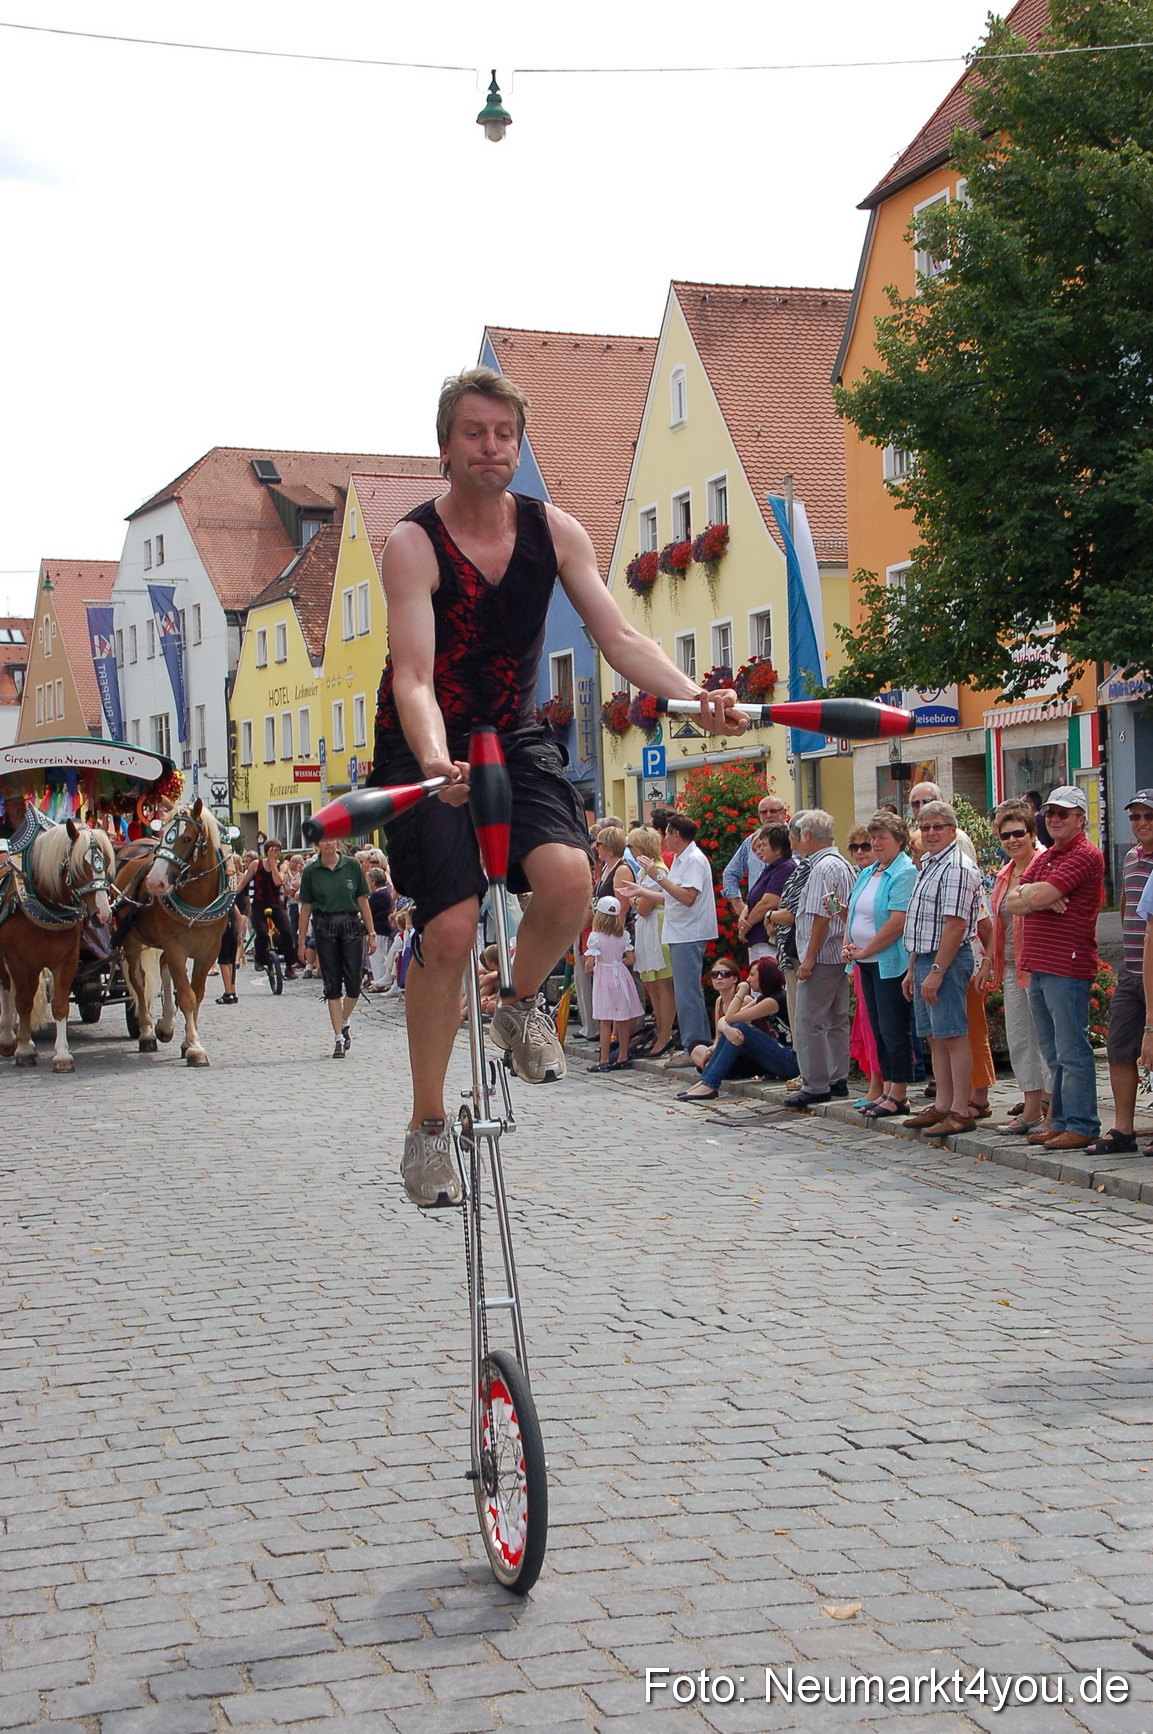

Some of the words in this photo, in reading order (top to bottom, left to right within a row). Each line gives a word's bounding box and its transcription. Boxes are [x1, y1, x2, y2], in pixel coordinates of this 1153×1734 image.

[268, 686, 290, 708] HOTEL
[294, 683, 319, 700] Lehmeier
[580, 694, 593, 756] WITTL
[1119, 731, 1125, 743] 6
[4, 753, 63, 765] Circusverein
[64, 754, 111, 765] Neumarkt
[119, 756, 138, 766] e.V.
[647, 750, 661, 775] P
[269, 783, 299, 797] Restaurant
